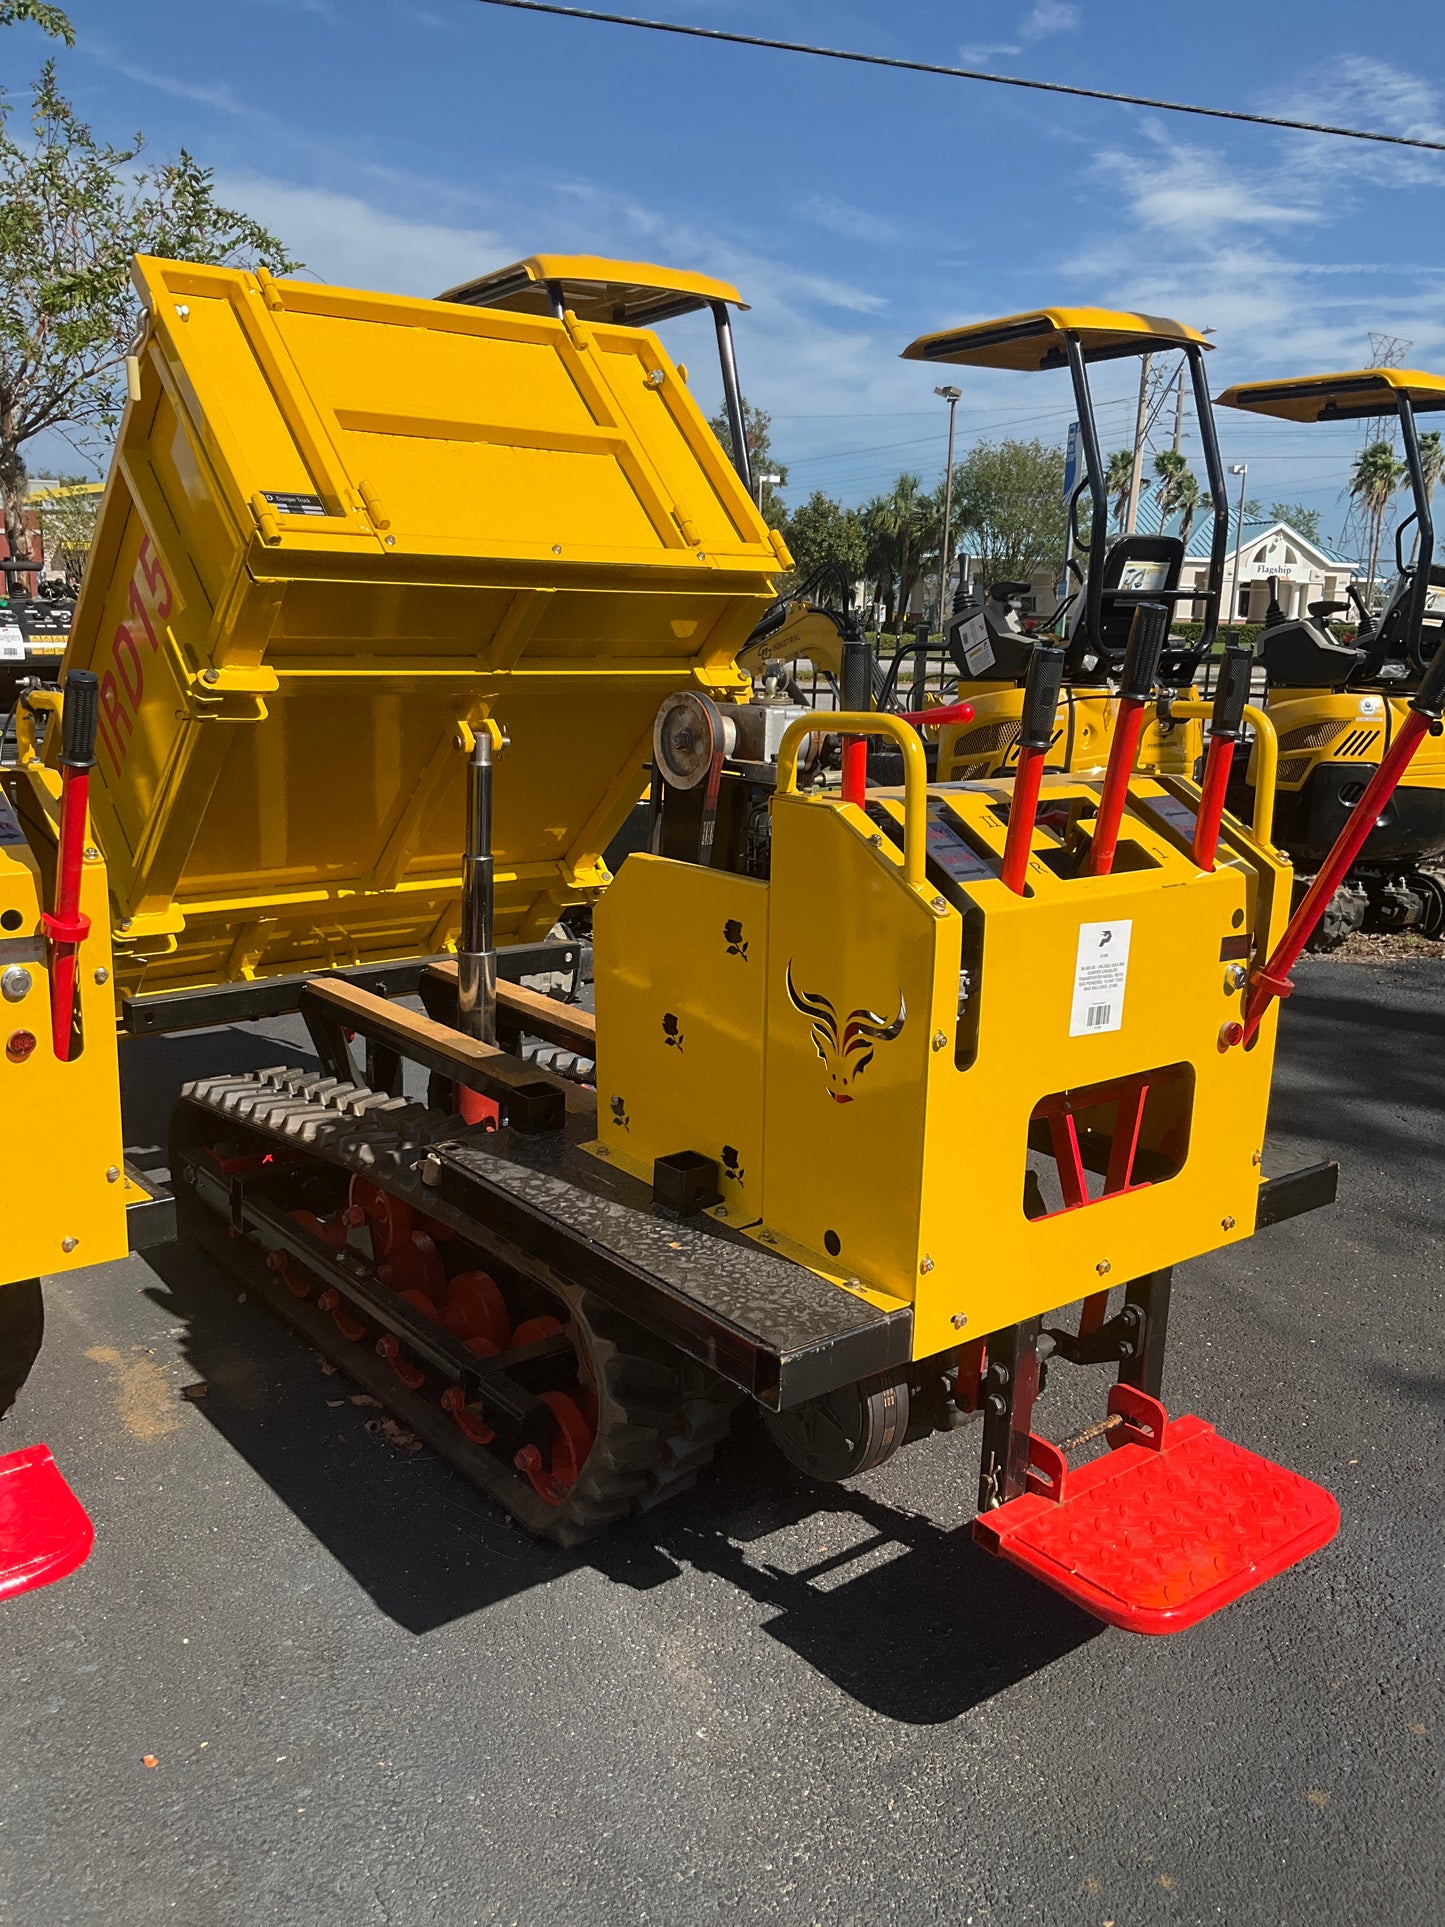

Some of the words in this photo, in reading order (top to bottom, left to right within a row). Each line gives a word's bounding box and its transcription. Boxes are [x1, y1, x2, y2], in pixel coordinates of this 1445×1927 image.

[1257, 564, 1292, 577] Flagship
[773, 632, 801, 651] INDUSTRIAL
[1029, 861, 1049, 875] R
